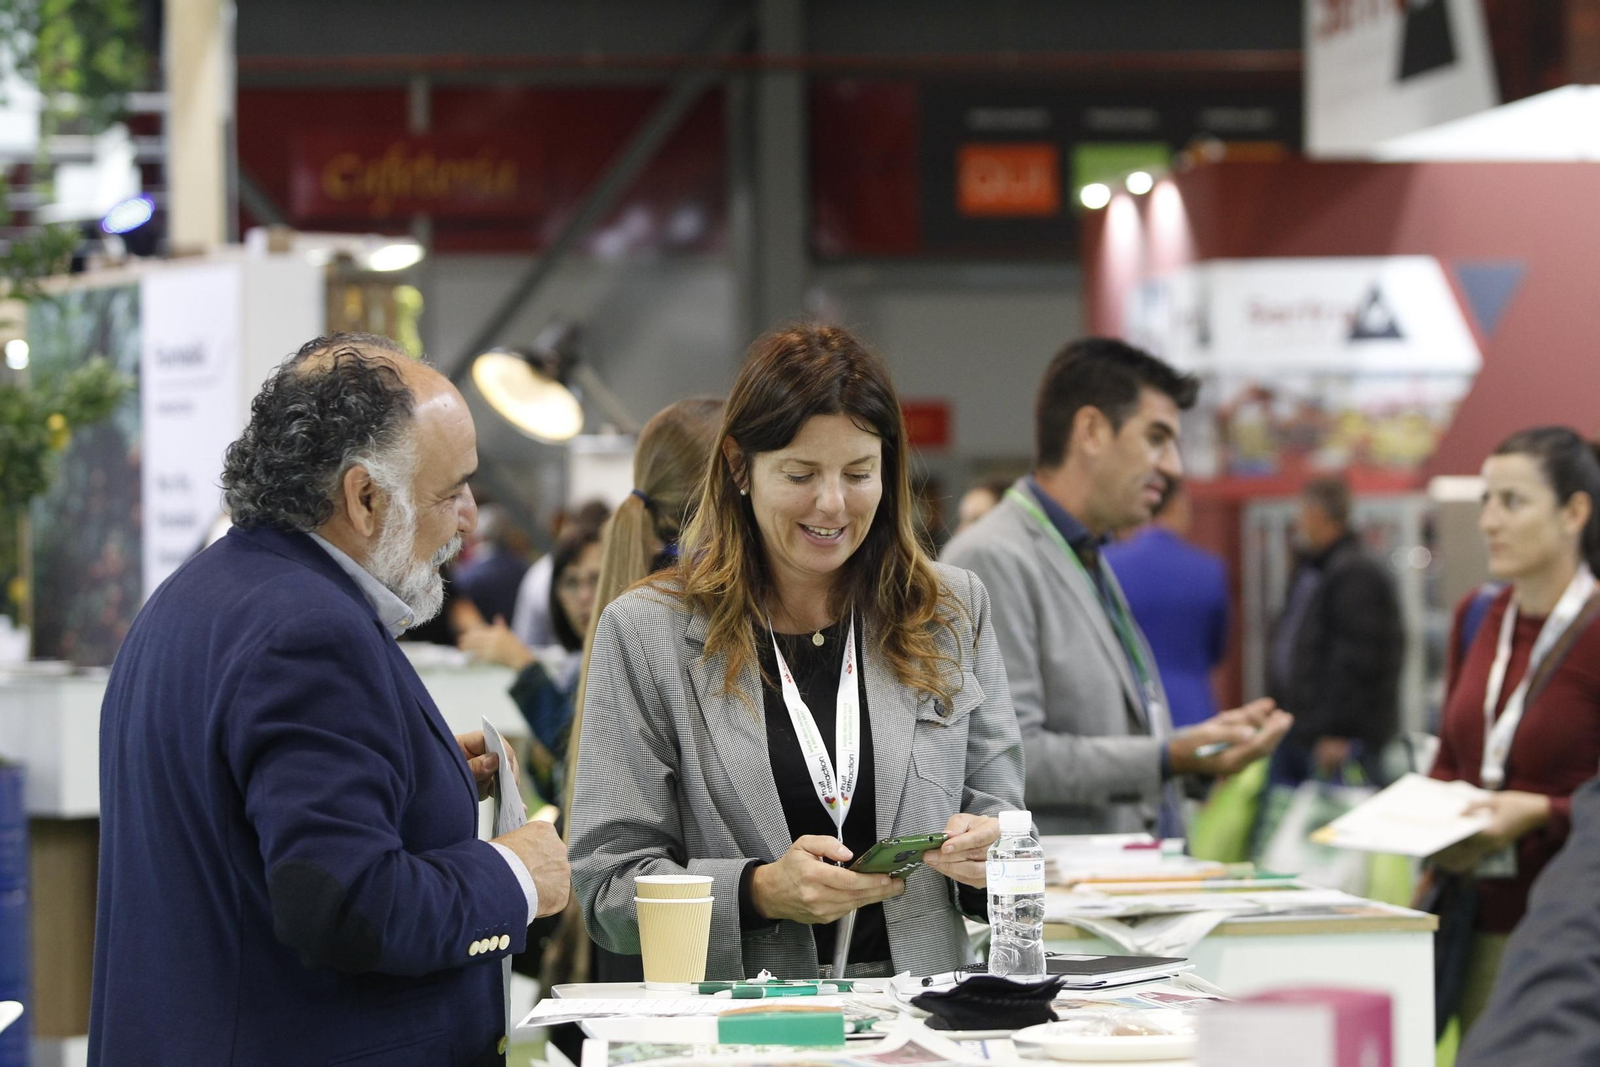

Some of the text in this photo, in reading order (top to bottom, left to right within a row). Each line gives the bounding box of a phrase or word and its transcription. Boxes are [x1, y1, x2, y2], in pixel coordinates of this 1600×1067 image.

[818, 756, 834, 794] attraction
[818, 780, 828, 797] fruit
[846, 753, 855, 793] attraction
